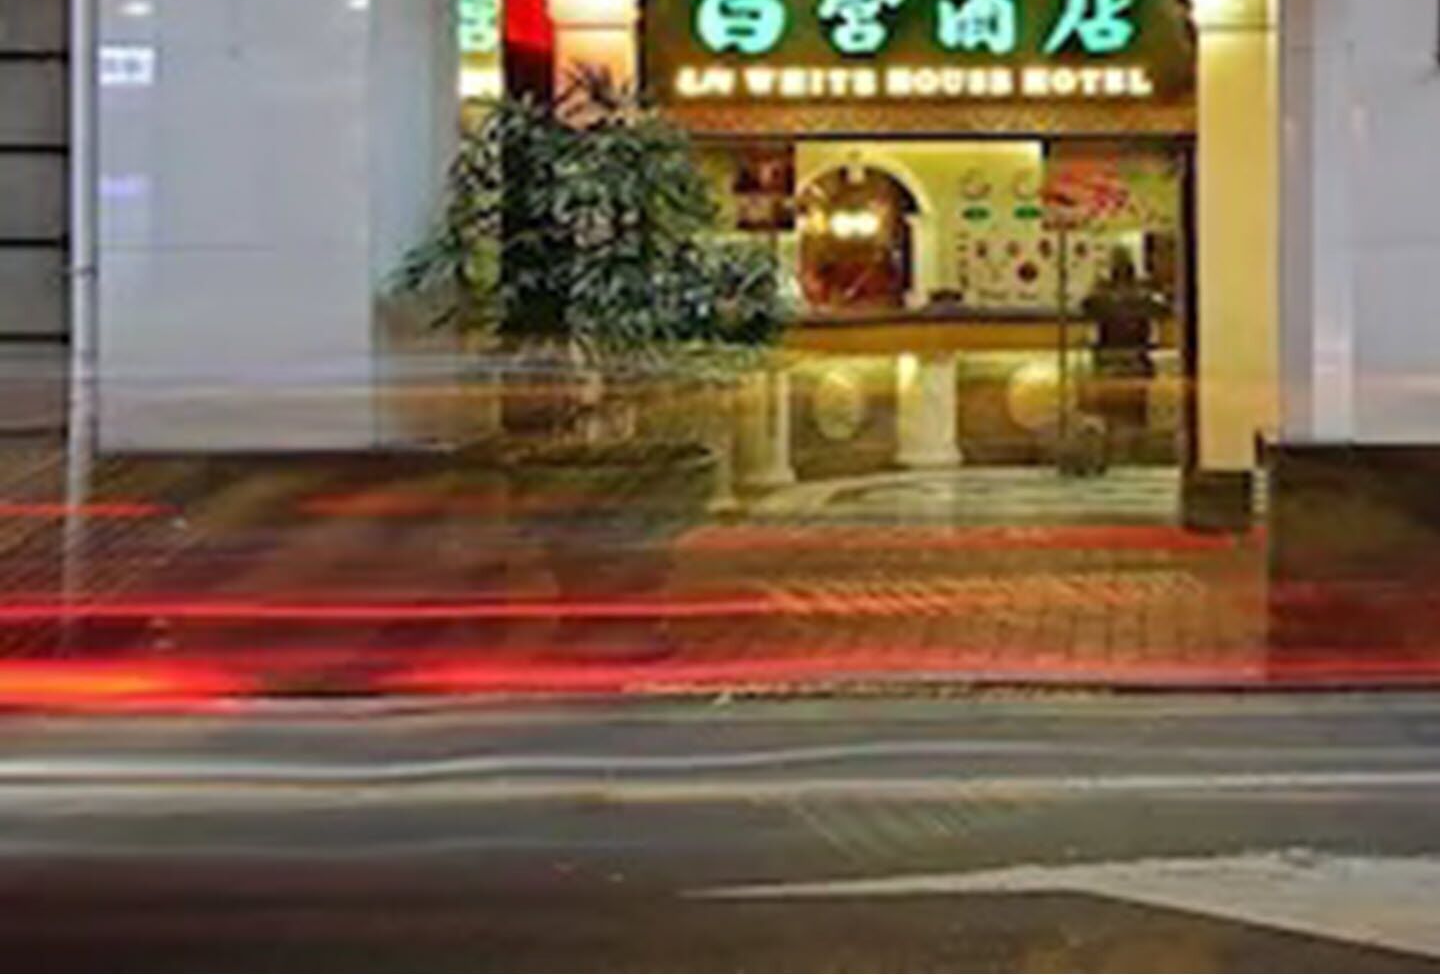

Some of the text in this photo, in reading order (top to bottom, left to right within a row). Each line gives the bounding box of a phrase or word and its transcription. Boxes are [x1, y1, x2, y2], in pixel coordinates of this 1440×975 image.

[743, 67, 877, 96] WHITE
[886, 67, 1013, 96] HOUSE
[1022, 67, 1153, 96] HOTEL
